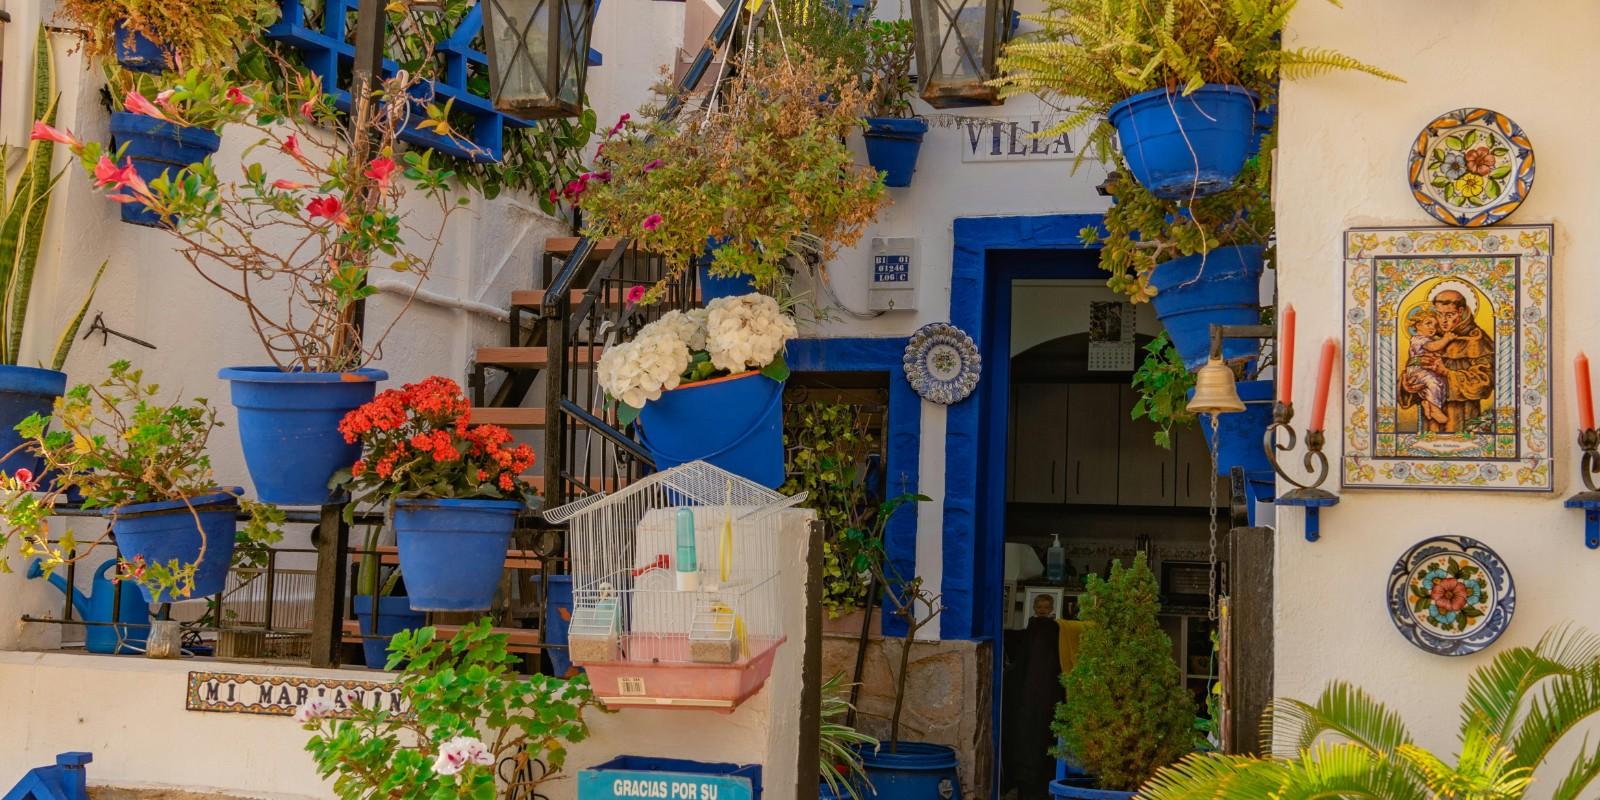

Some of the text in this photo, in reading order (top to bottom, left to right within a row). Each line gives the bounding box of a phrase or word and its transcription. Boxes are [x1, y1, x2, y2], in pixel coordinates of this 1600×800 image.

[965, 120, 1074, 156] VILLA
[900, 273, 906, 281] C
[206, 682, 235, 702] MI
[613, 779, 718, 800] GRACIAS POR SU
